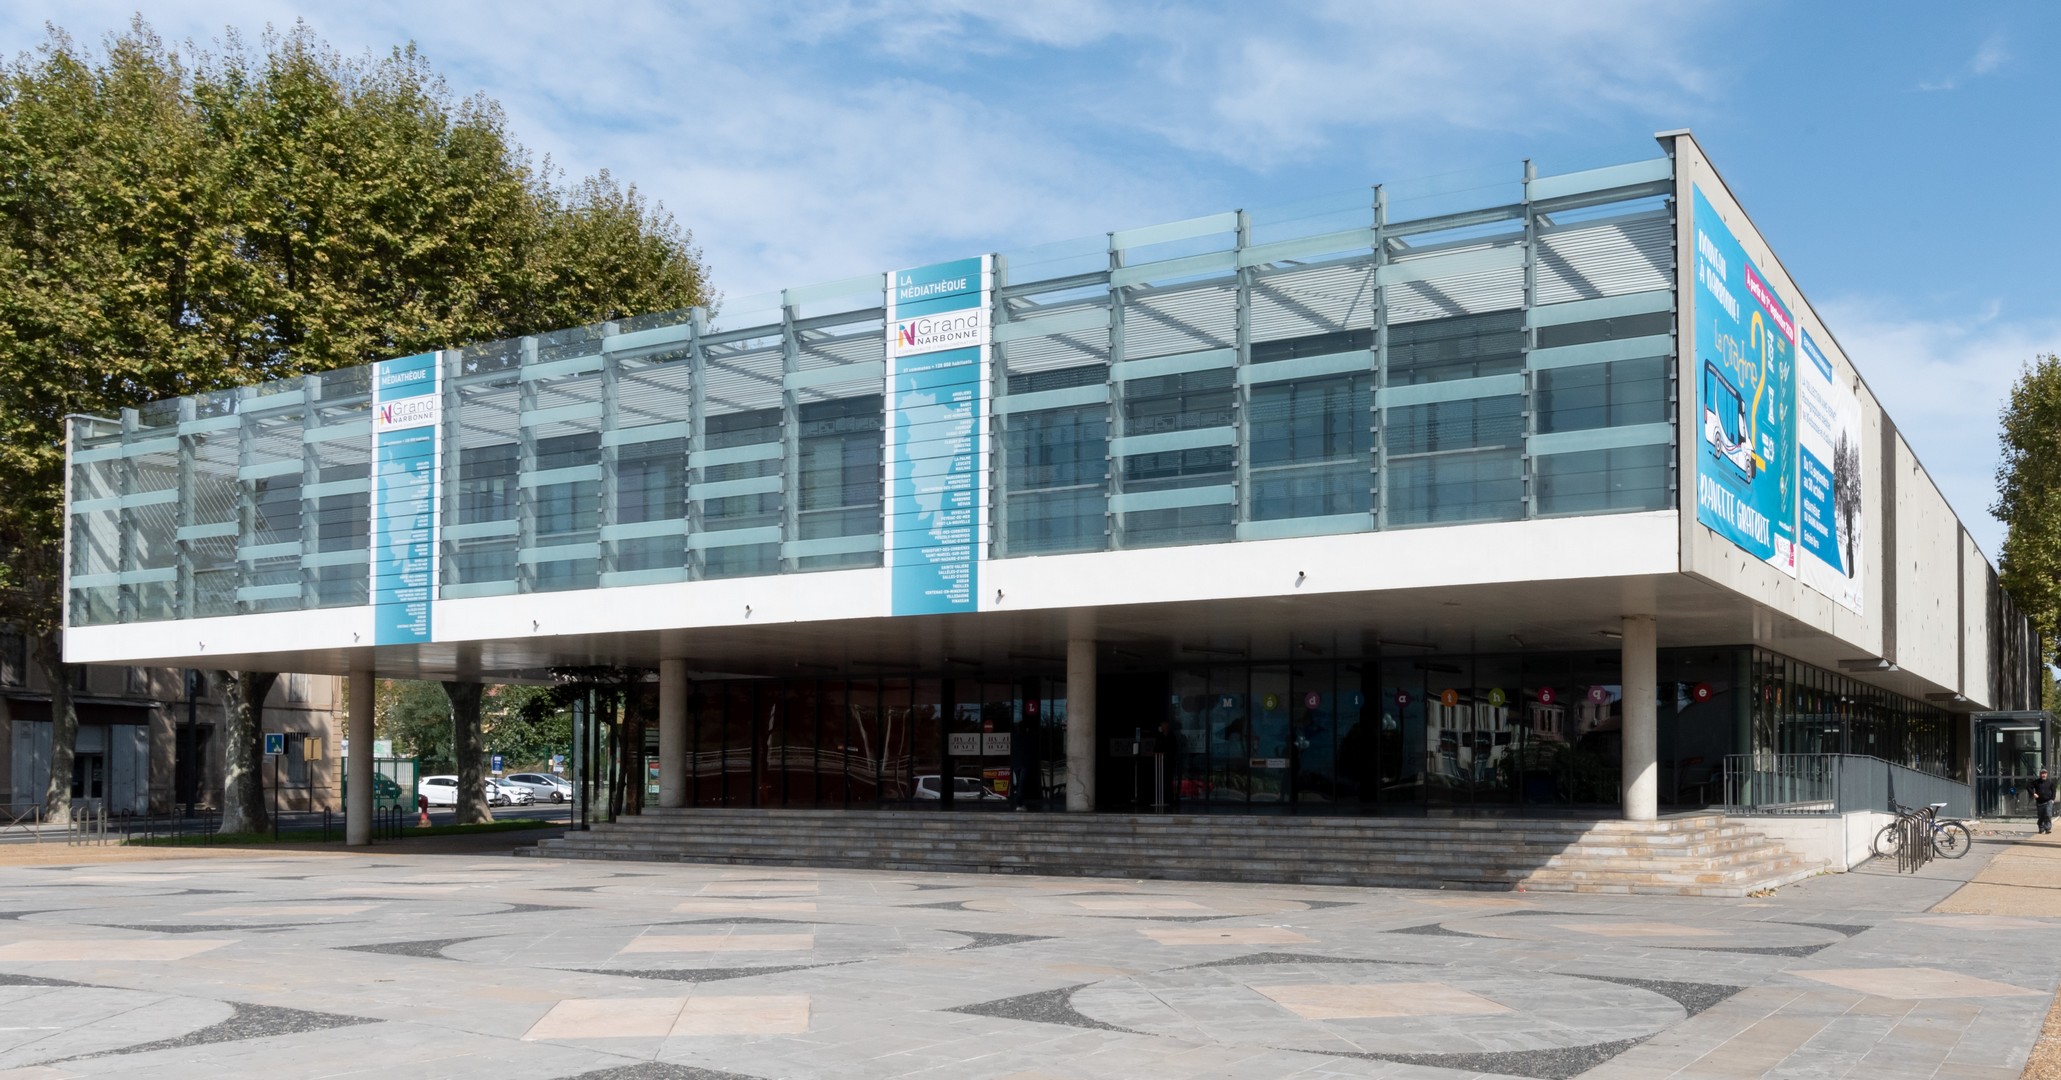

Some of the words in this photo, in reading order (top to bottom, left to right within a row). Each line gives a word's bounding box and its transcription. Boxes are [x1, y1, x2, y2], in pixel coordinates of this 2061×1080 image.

[1699, 228, 1726, 282] NOUVEAU
[1699, 256, 1704, 284] À
[901, 275, 912, 286] LA
[901, 278, 967, 299] MÉDIATHÈQUE
[918, 312, 978, 334] Grand
[917, 330, 978, 345] NARBONNE
[382, 366, 390, 374] LA
[382, 370, 426, 385] MÉDIATHÈQUE
[393, 398, 433, 415] Grand
[393, 412, 433, 423] NARBONNE
[1700, 472, 1735, 525] NAVETTE
[1737, 499, 1770, 548] GRATUITE
